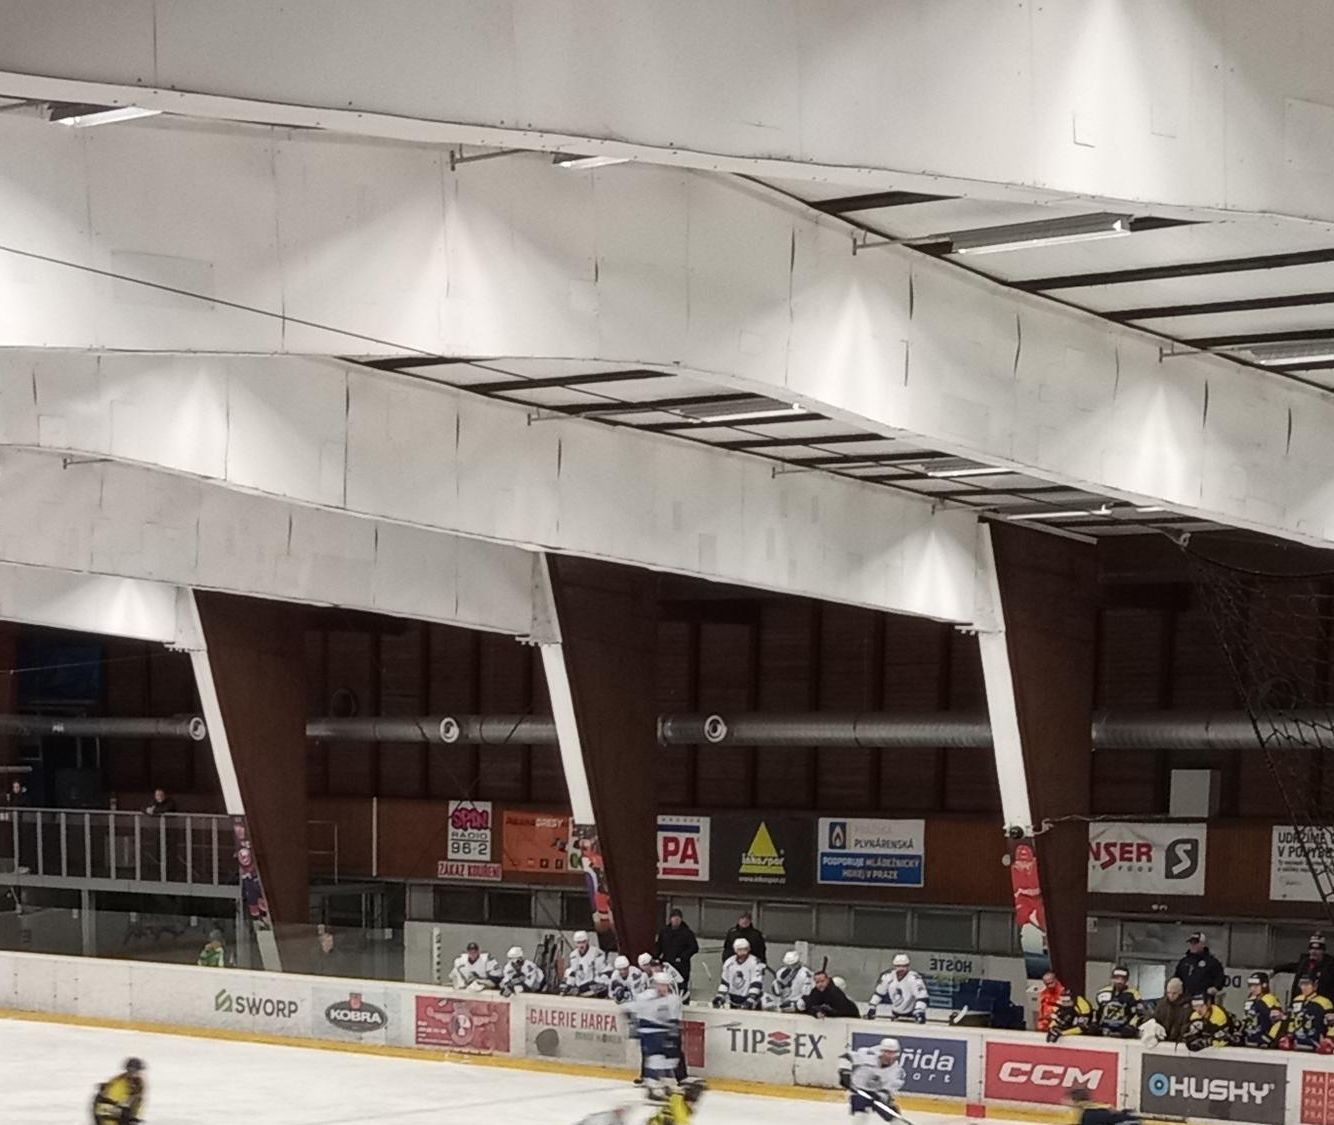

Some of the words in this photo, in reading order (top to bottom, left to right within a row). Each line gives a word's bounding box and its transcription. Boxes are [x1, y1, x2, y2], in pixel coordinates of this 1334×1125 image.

[662, 836, 700, 864] PA
[1089, 842, 1153, 870] NSER
[235, 996, 298, 1018] SWORP
[330, 1009, 382, 1024] KOBRA
[530, 1009, 577, 1028] GALERIE
[581, 1012, 618, 1032] HARFA
[727, 1028, 766, 1053] TIP
[999, 1061, 1104, 1090] CCM
